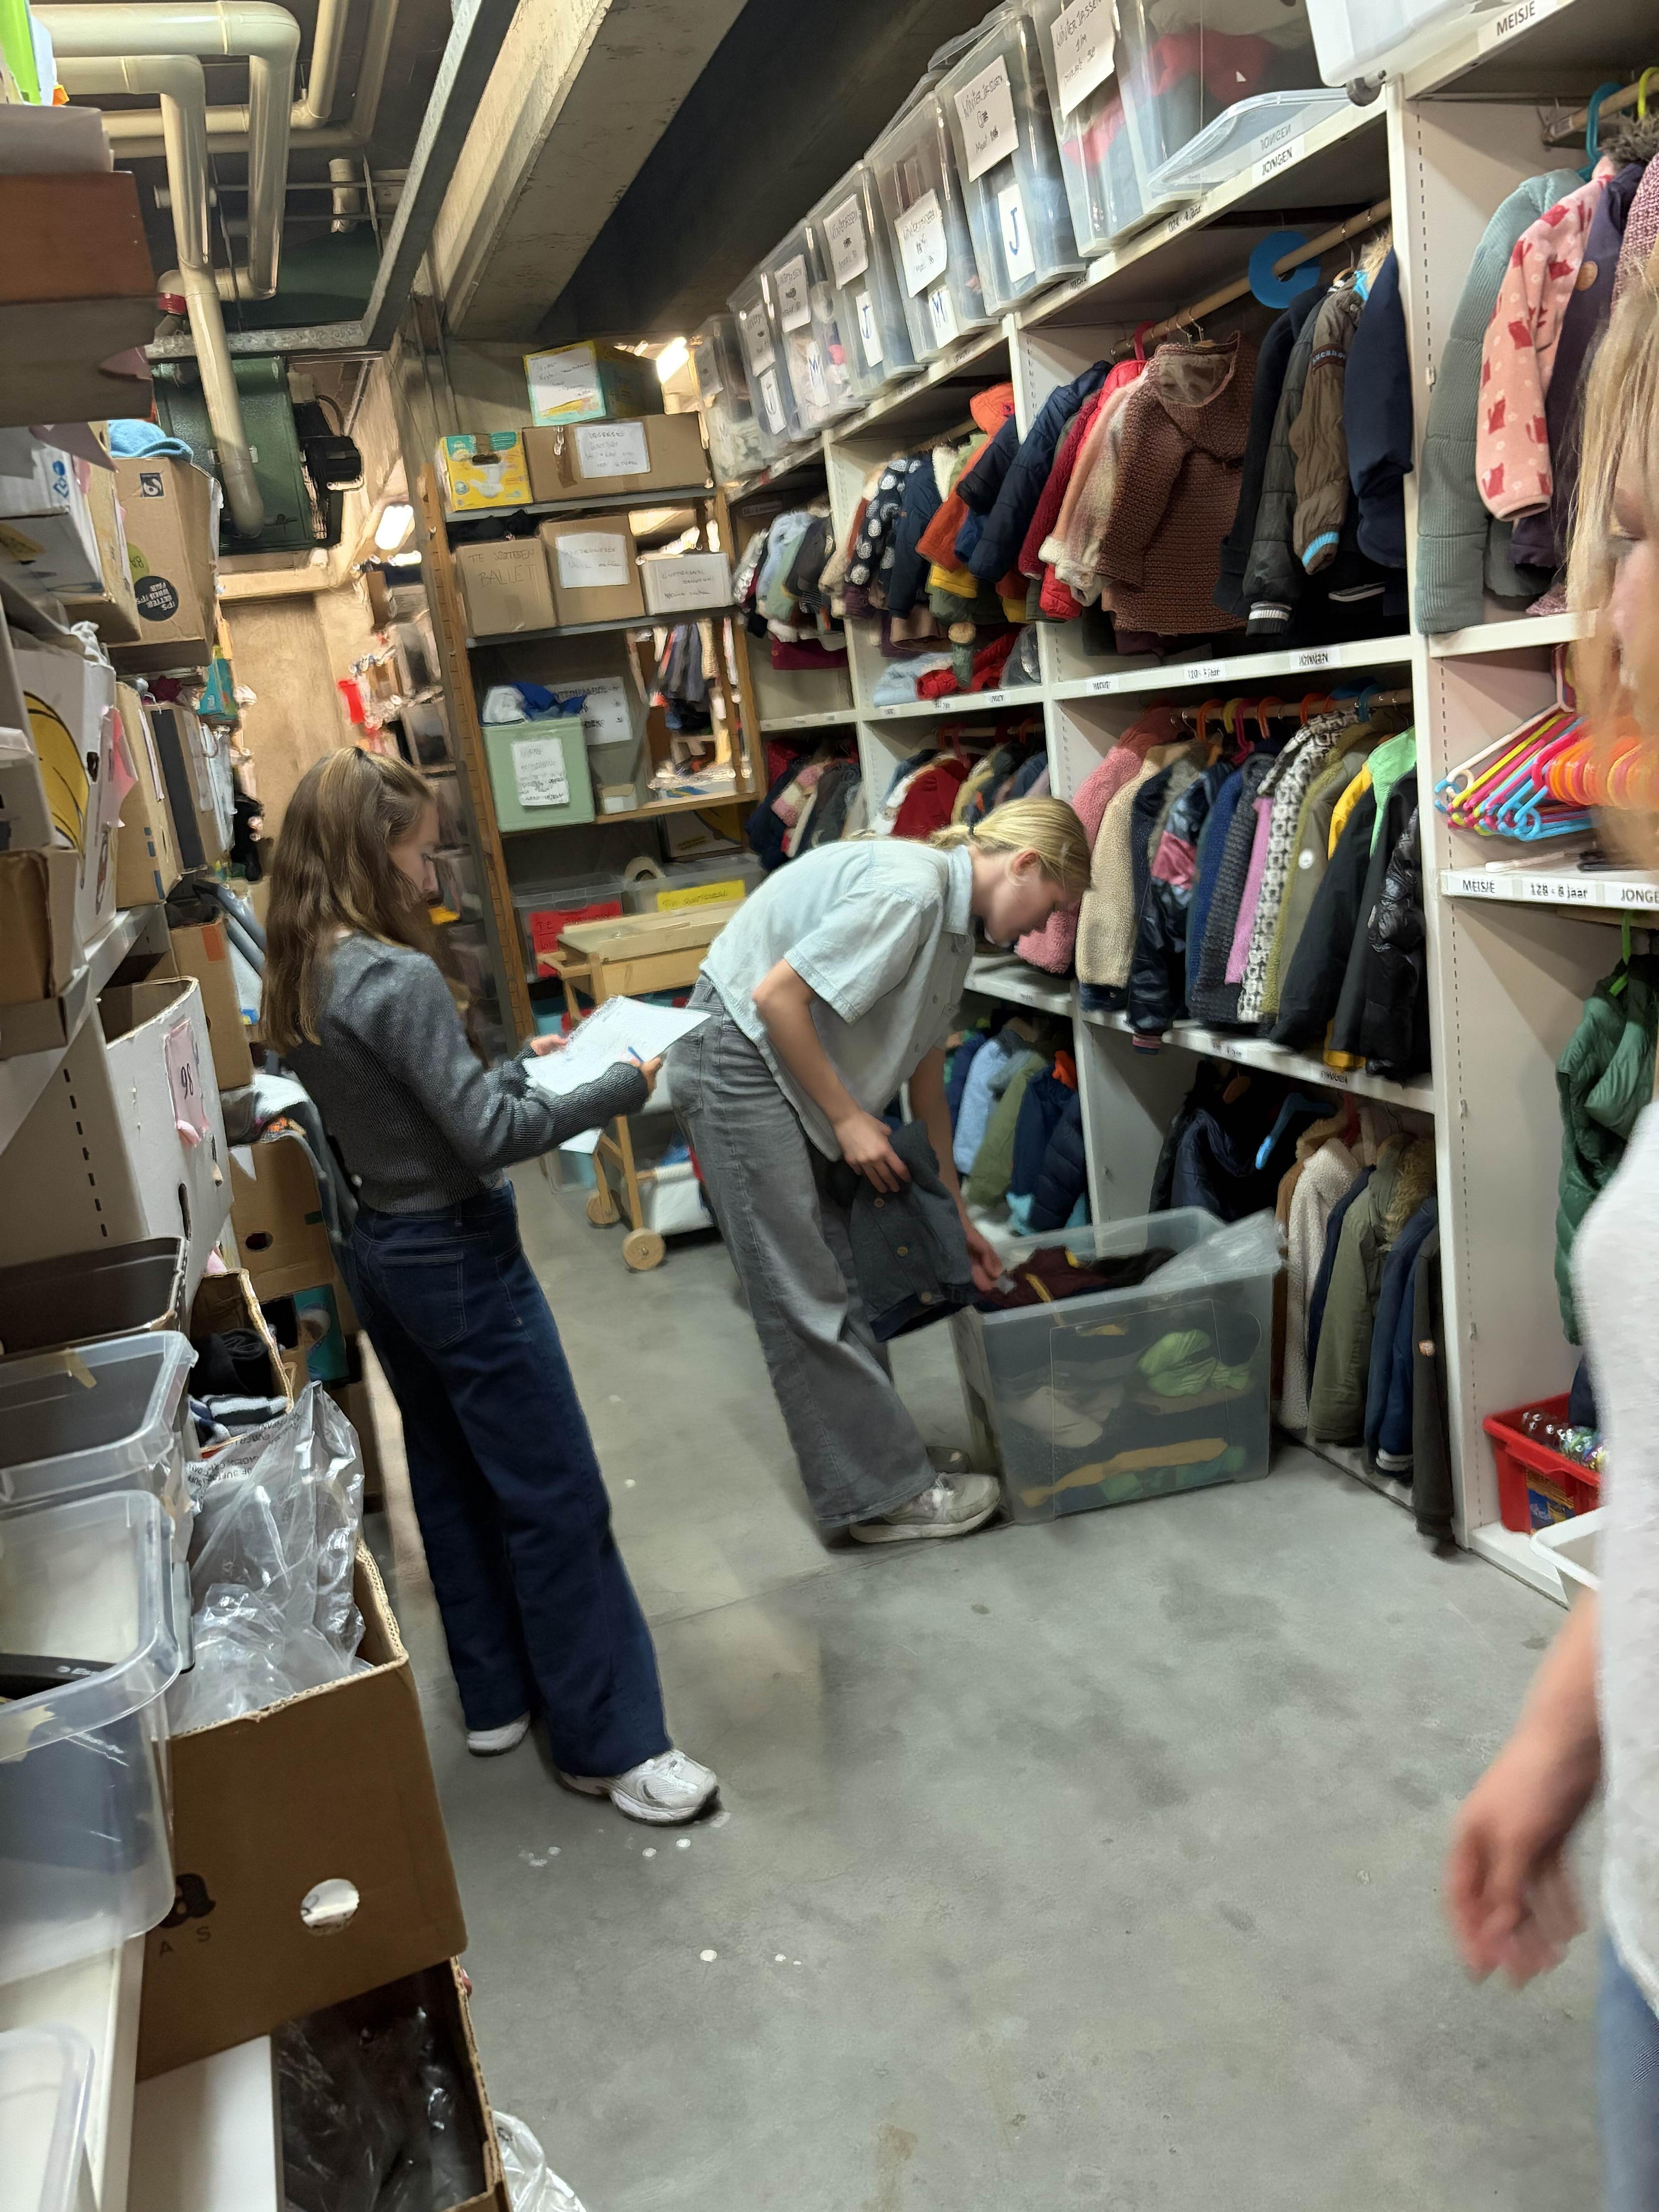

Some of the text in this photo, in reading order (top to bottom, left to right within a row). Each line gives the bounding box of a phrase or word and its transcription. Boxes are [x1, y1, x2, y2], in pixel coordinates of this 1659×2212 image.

[1497, 0, 1535, 36] MEISJE
[1262, 147, 1293, 176] JONGEN
[1009, 207, 1020, 256] J
[861, 305, 871, 339] J
[932, 290, 948, 329] M
[468, 553, 485, 563] TE
[478, 564, 536, 588] BALLET
[1462, 879, 1496, 893] MEISJE
[1567, 886, 1588, 899] jaar
[535, 920, 553, 931] TE
[181, 1063, 194, 1100] 98
